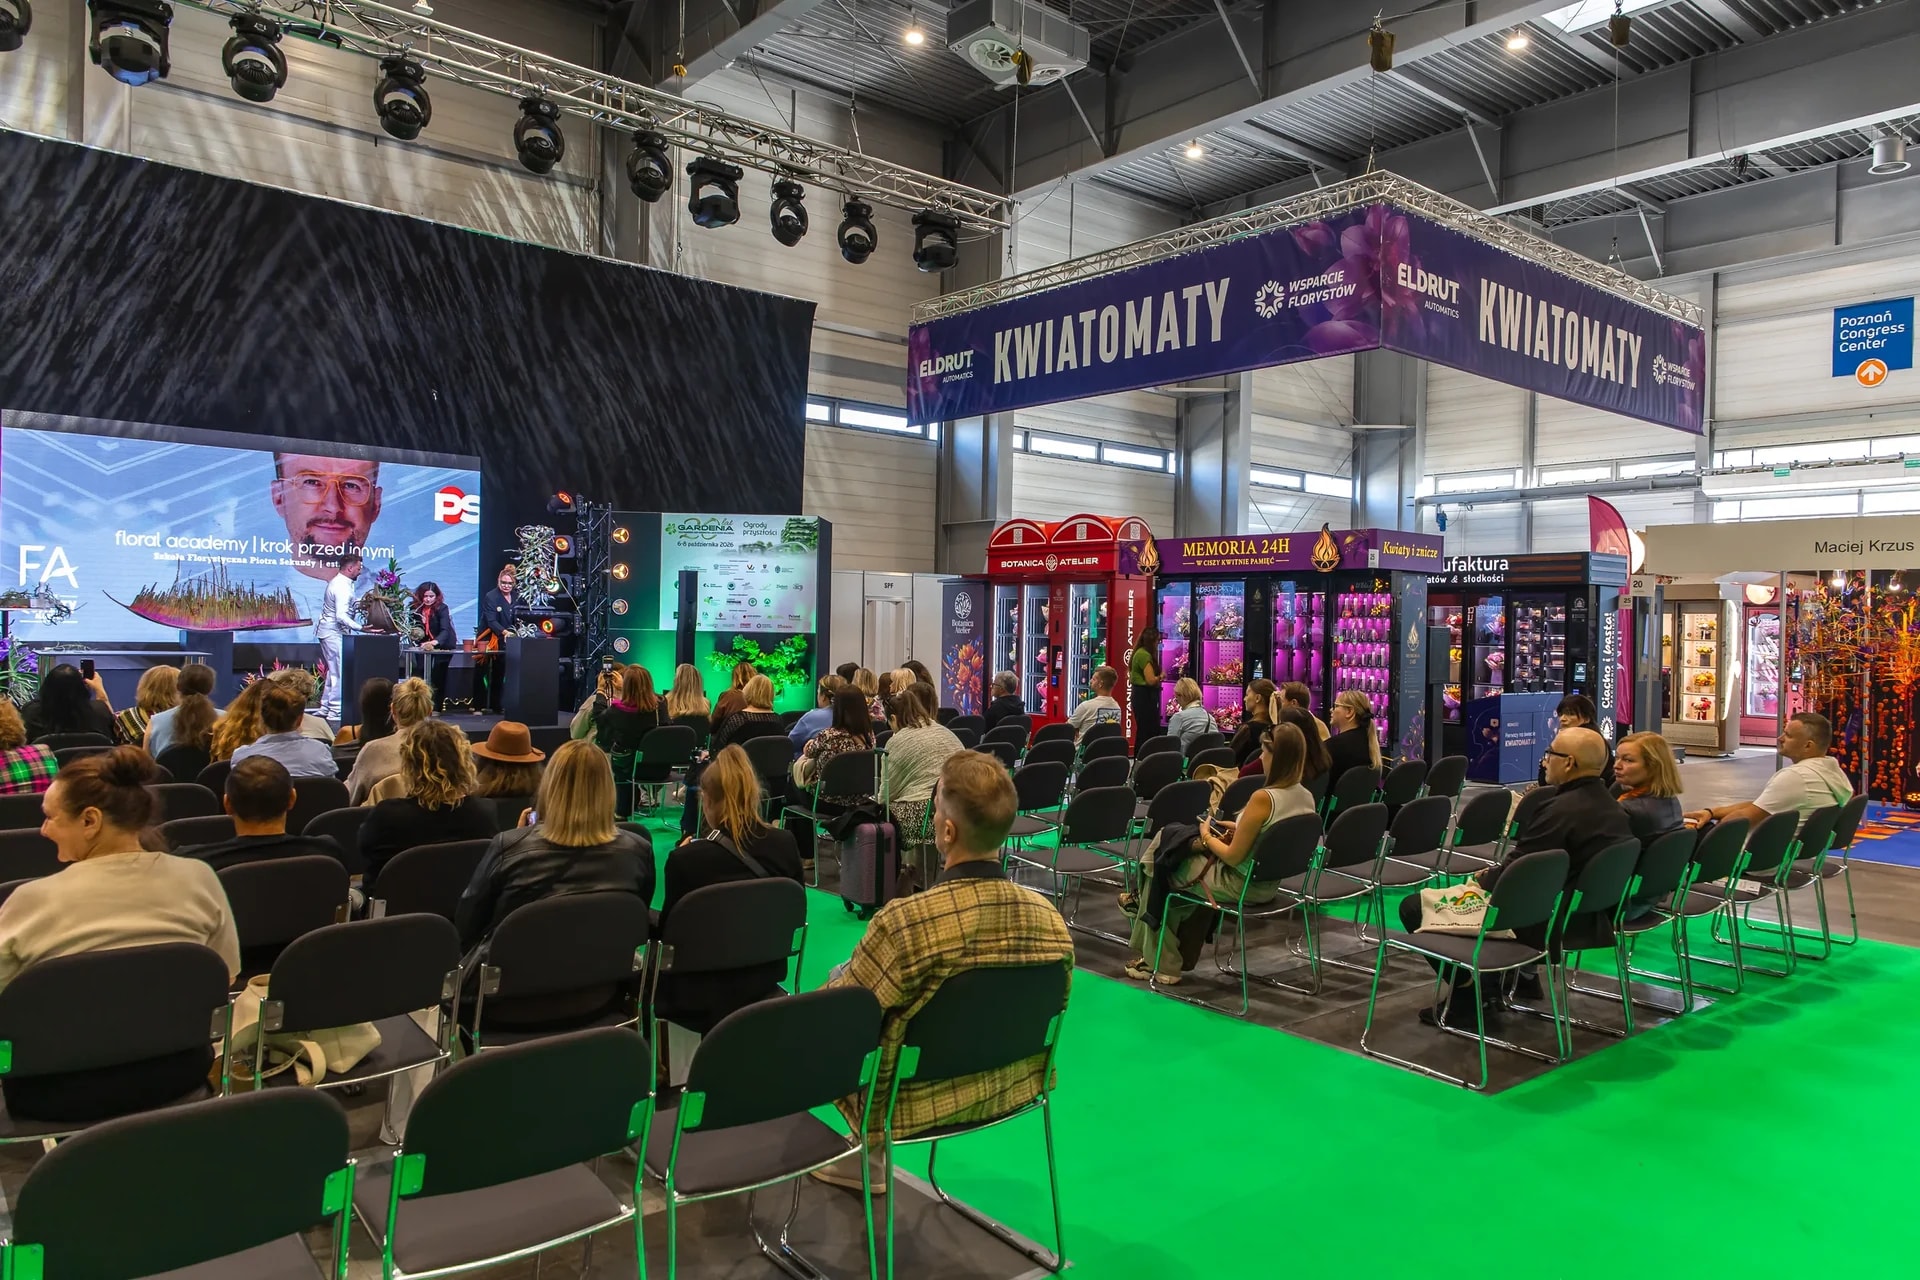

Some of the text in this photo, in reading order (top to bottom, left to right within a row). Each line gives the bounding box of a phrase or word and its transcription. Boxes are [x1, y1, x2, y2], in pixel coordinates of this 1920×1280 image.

[1289, 270, 1345, 293] WSPARCIE
[1398, 262, 1460, 304] ELDRUT
[1288, 283, 1357, 309] FLORYSTÓW
[1424, 300, 1460, 319] AUTOMATICS
[1840, 310, 1892, 328] Poznań
[994, 277, 1230, 384] KWIATOMATY
[1479, 278, 1642, 389] KWIATOMATY
[1840, 323, 1905, 340] Congress
[1840, 338, 1888, 353] Center
[920, 350, 974, 378] ELDRUT
[1667, 362, 1691, 378] WSPARCIE
[942, 371, 974, 383] AUTOMATICS
[677, 524, 734, 532] GARDENIA
[742, 521, 767, 529] Ogrody
[742, 529, 777, 537] przyszłości
[115, 530, 161, 547] floral
[166, 535, 249, 554] academy
[260, 538, 295, 554] krok
[298, 542, 345, 557] przed
[349, 543, 395, 560] innymi
[1183, 538, 1291, 557] MEMORIA 24H
[1383, 541, 1411, 559] Kwiaty
[1416, 545, 1438, 558] znicze
[1815, 540, 1914, 555] Maciej Krzus
[20, 545, 79, 589] FA
[187, 553, 247, 564] Florystyczna
[250, 556, 277, 565] Piotra
[280, 558, 316, 568] Sekundy
[1001, 557, 1099, 568] BOTANICA ATELIER
[1221, 558, 1249, 566] KWITNIE
[1250, 556, 1275, 565] PAMIĘĆ
[1425, 574, 1447, 584] atów
[1463, 573, 1504, 583] słodkości
[1633, 580, 1643, 588] 20
[951, 618, 974, 627] Botanica
[955, 626, 971, 634] Atelier
[1603, 612, 1612, 655] basta!
[1602, 665, 1611, 708] Ciacho
